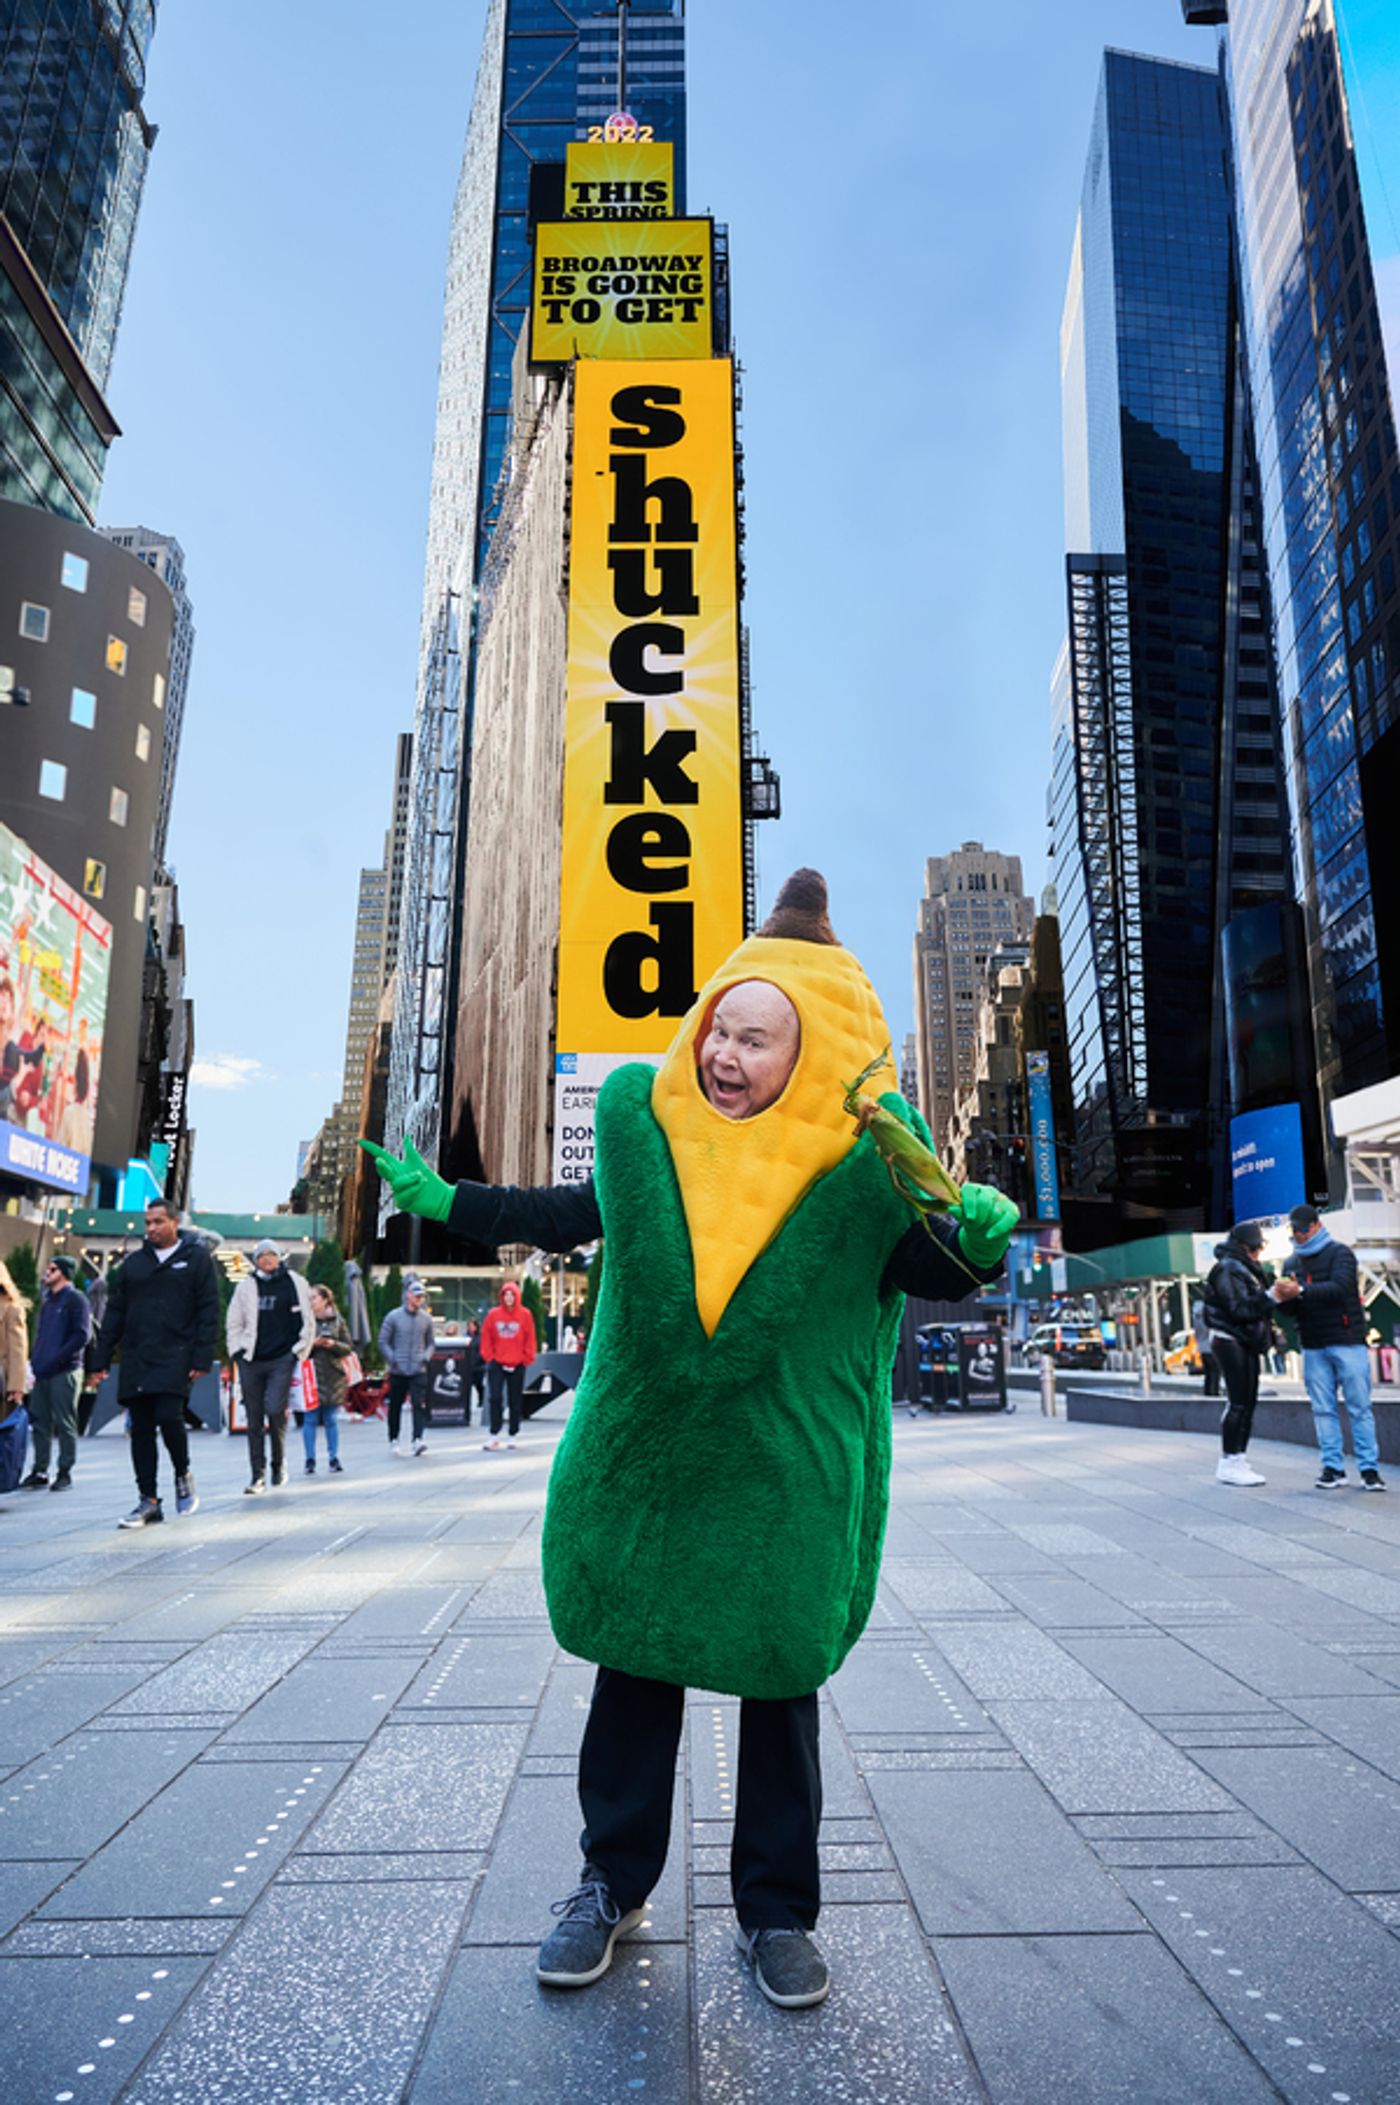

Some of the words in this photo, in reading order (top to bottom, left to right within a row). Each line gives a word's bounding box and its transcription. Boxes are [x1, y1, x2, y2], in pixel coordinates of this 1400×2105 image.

[587, 126, 654, 143] 2022
[571, 181, 668, 203] THIS
[569, 205, 668, 219] SPRING
[543, 255, 704, 272] BROADWAY
[541, 275, 576, 295] IS
[587, 274, 704, 295] GOING
[541, 299, 601, 323] TO
[615, 297, 704, 323] GET
[603, 385, 699, 1019] shucked
[164, 1076, 185, 1128] Locker
[561, 1146, 595, 1160] OUT
[561, 1165, 595, 1180] GET
